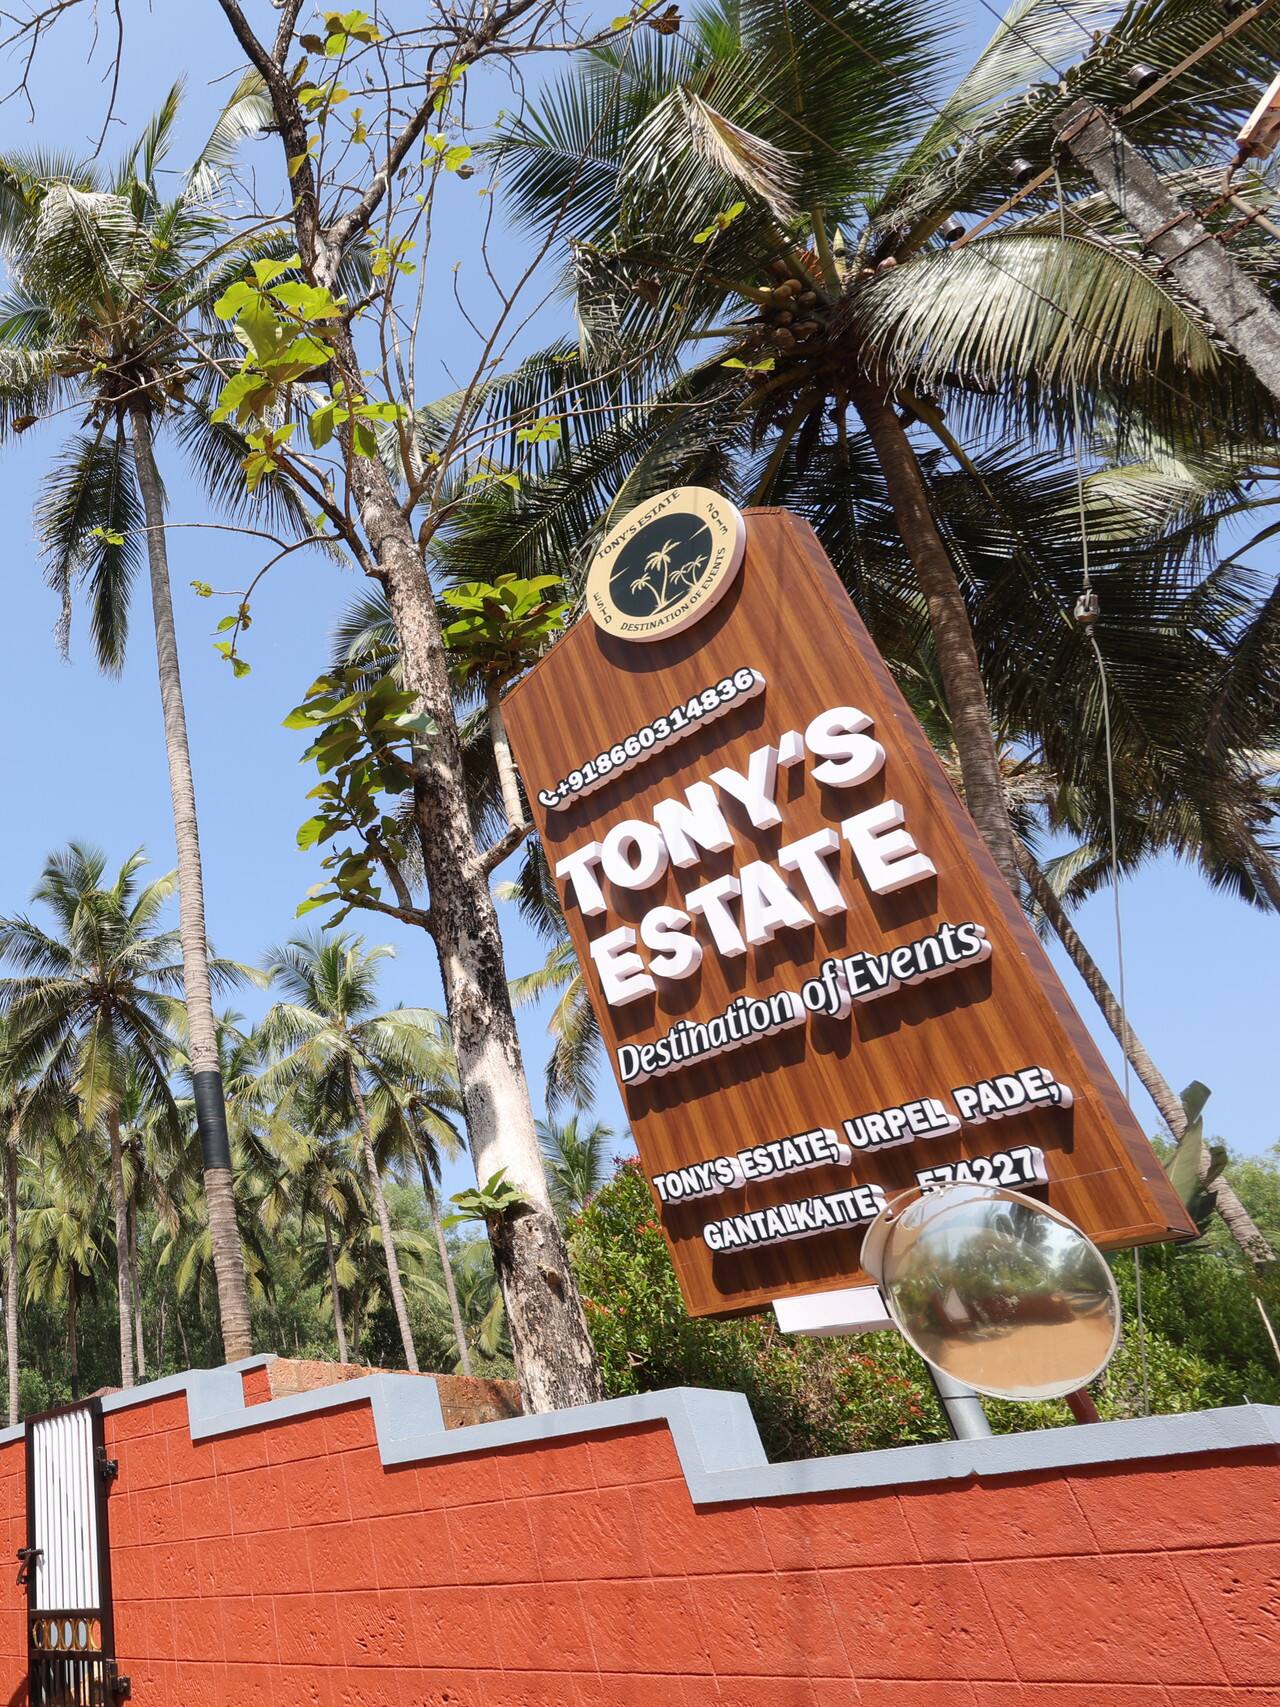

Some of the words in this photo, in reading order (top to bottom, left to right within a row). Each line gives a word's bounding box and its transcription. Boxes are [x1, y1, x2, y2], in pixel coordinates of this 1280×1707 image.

[596, 525, 637, 560] TONY'S
[638, 489, 681, 527] ESTATE
[620, 603, 690, 632] DESTINATION
[689, 588, 703, 605] OF
[701, 547, 727, 593] EVENTS
[593, 592, 613, 625] ESTD
[556, 667, 757, 797] +918660314836
[556, 706, 885, 916] TONY'S
[590, 799, 938, 1006] ESTATE
[617, 989, 797, 1083] Destination
[802, 958, 844, 1017] of
[842, 922, 986, 998] Events
[652, 1157, 735, 1201] TONY'S
[737, 1128, 839, 1179] ESTATE,
[842, 1098, 950, 1148] URPEL
[952, 1066, 1062, 1120] PADE,
